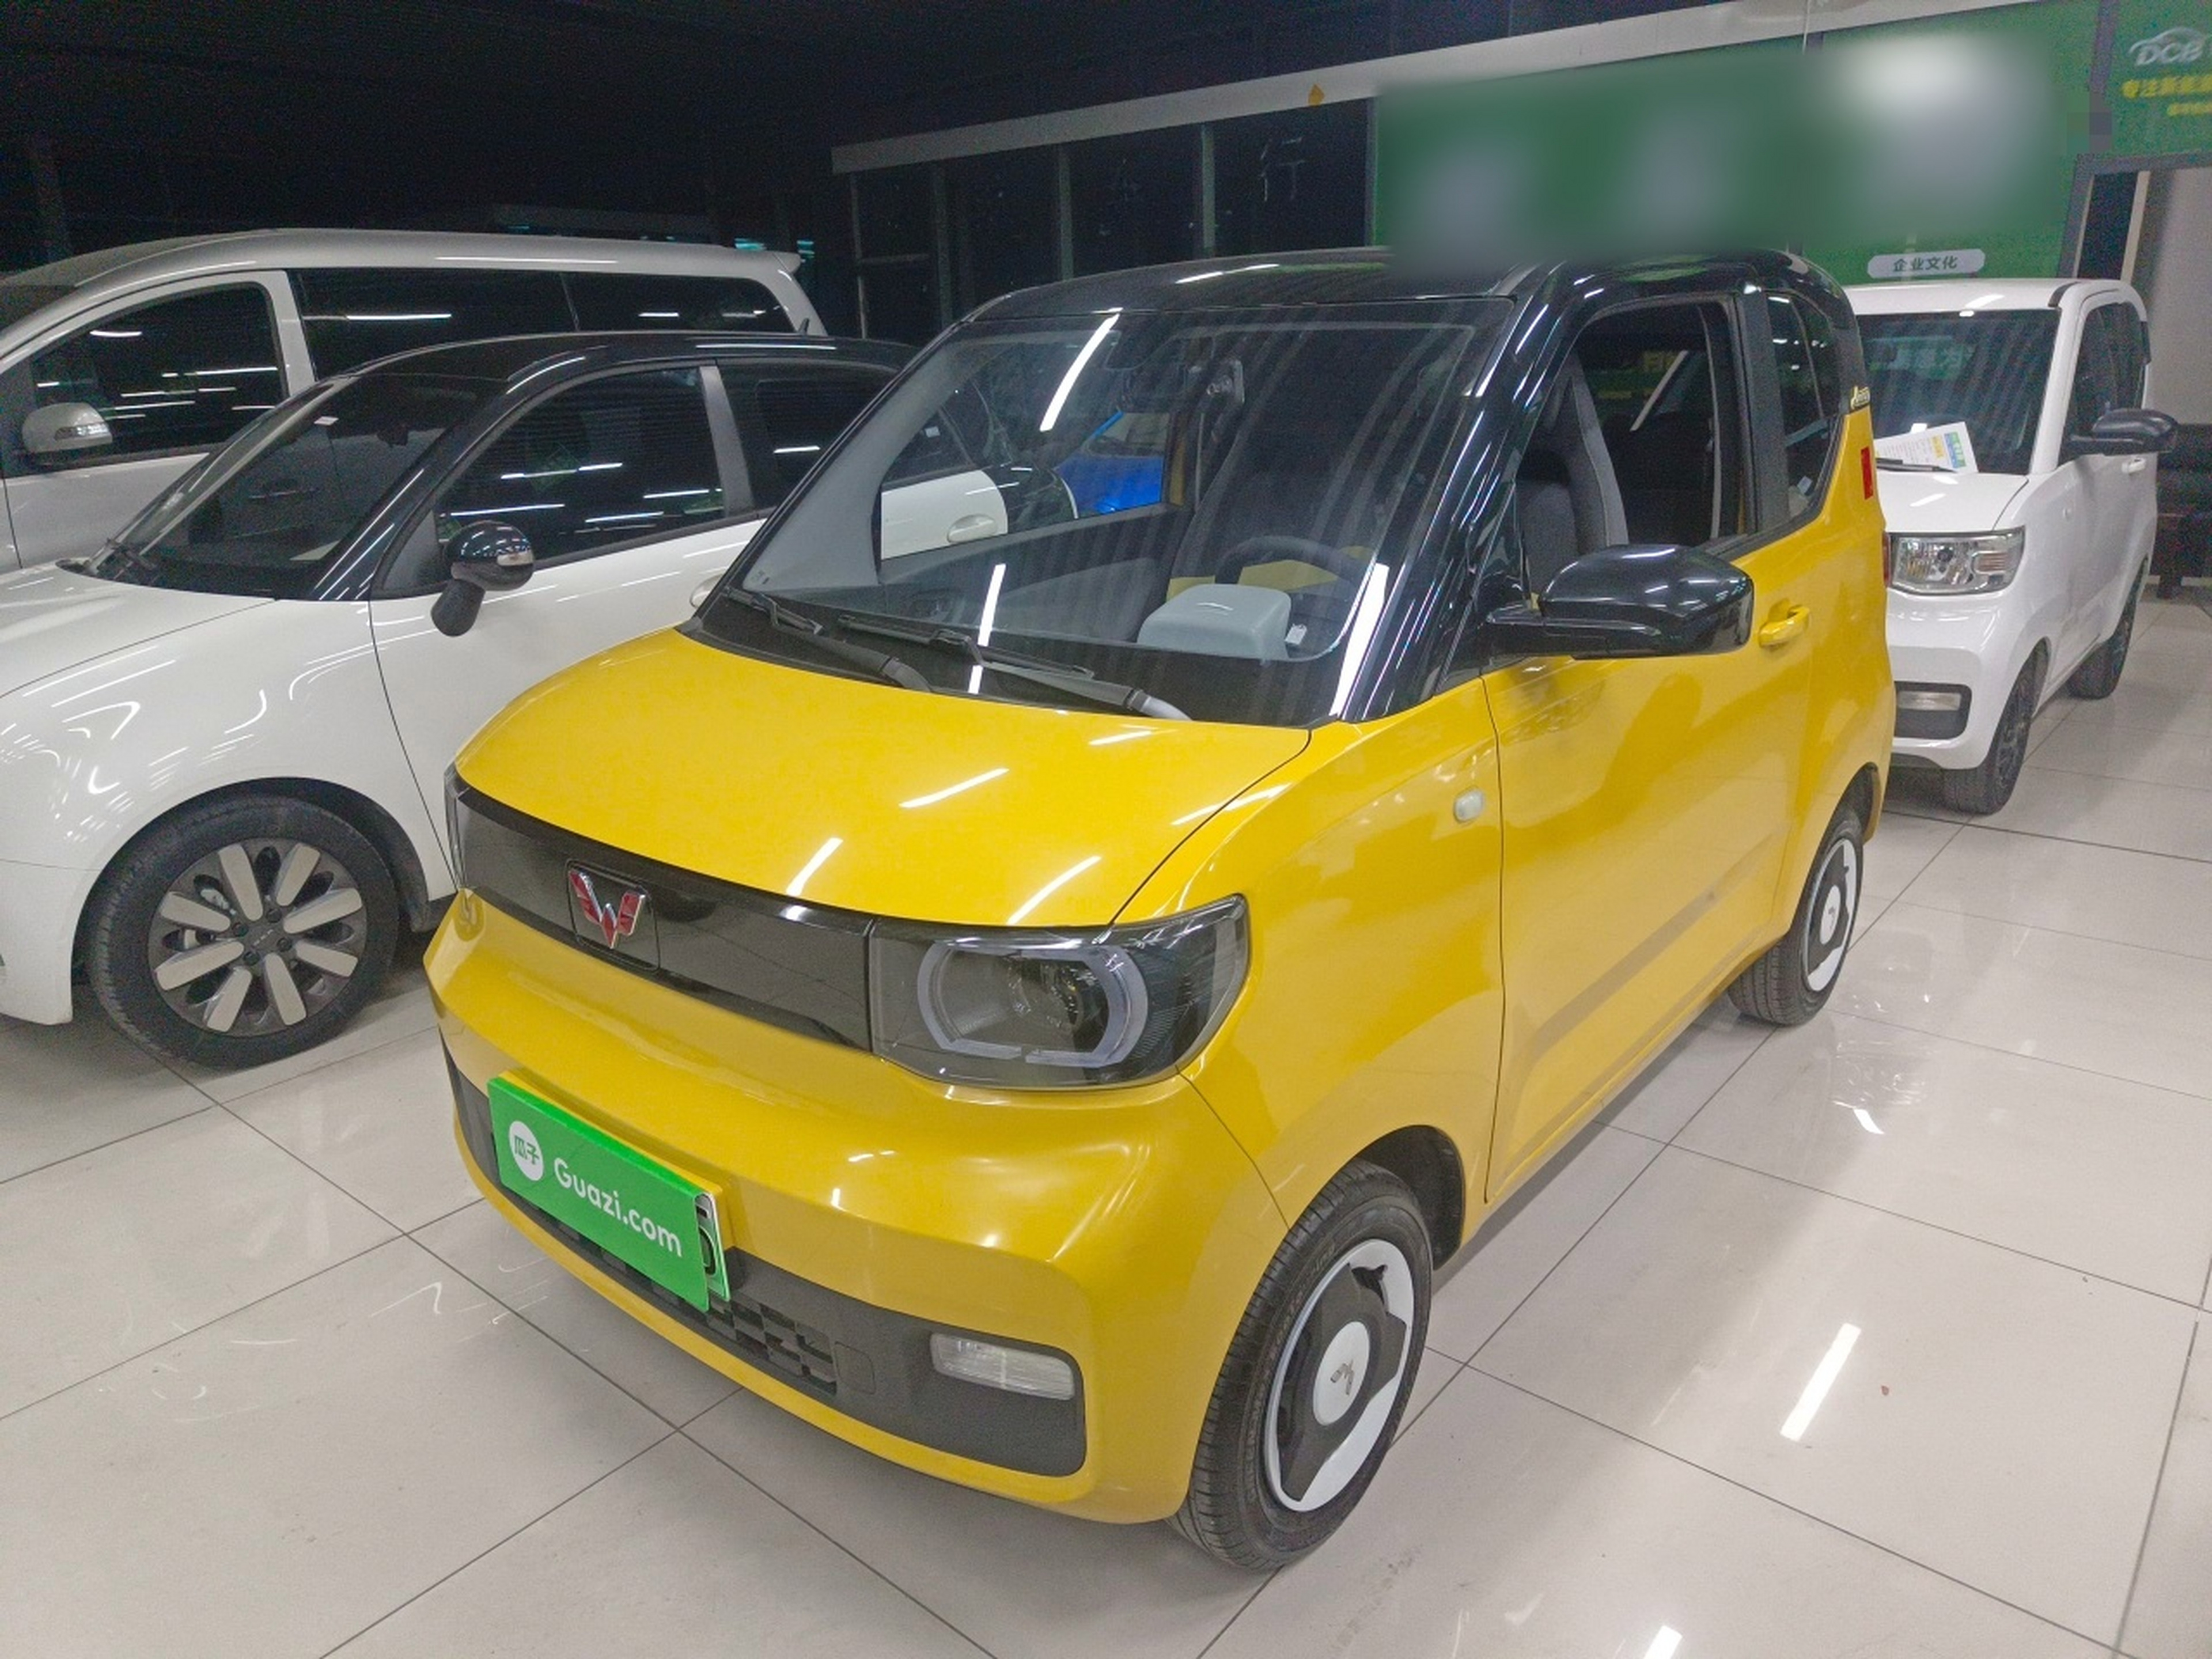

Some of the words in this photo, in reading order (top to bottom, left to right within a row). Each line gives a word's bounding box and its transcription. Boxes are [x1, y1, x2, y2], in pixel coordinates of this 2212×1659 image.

[1893, 255, 1959, 272] 企业文化
[513, 1134, 540, 1166] 瓜子
[553, 1158, 682, 1257] Guazi.com
